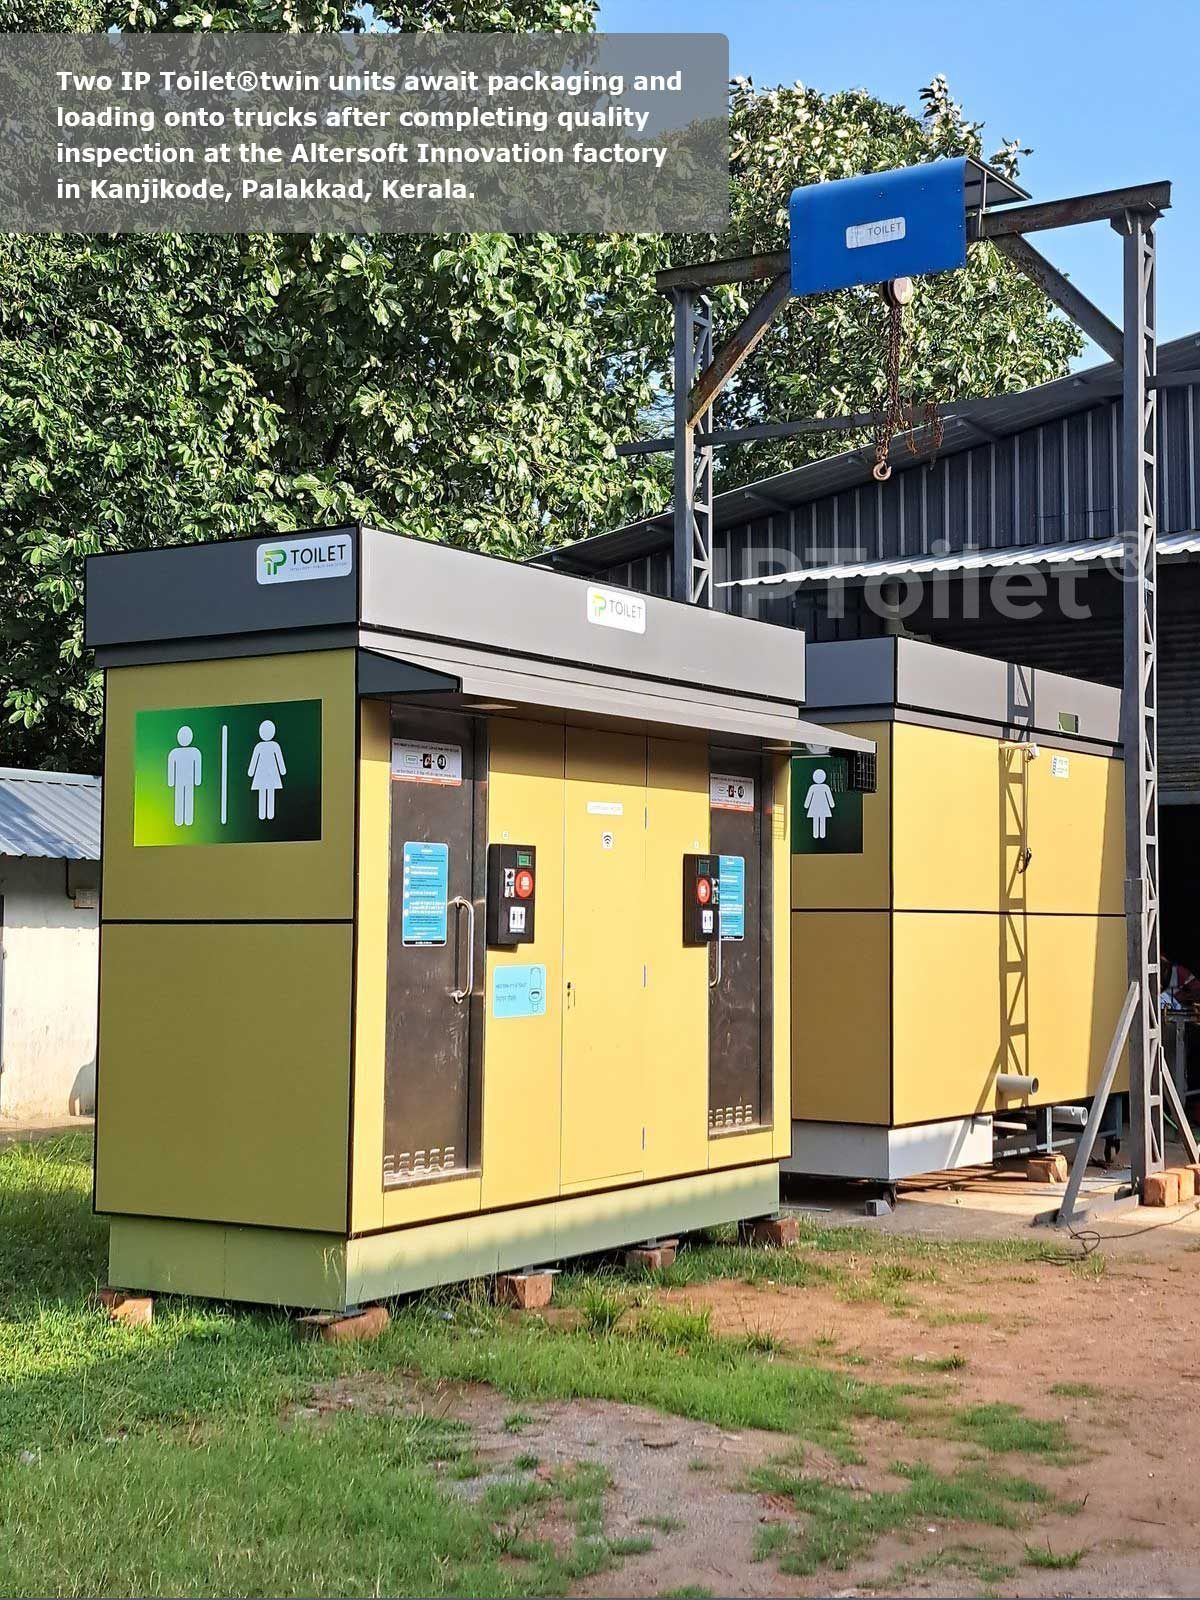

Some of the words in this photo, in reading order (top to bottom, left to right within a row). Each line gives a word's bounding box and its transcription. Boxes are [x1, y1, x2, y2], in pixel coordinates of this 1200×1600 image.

[867, 222, 902, 237] TOILET
[290, 544, 346, 565] TOILET
[608, 599, 643, 619] TOILET
